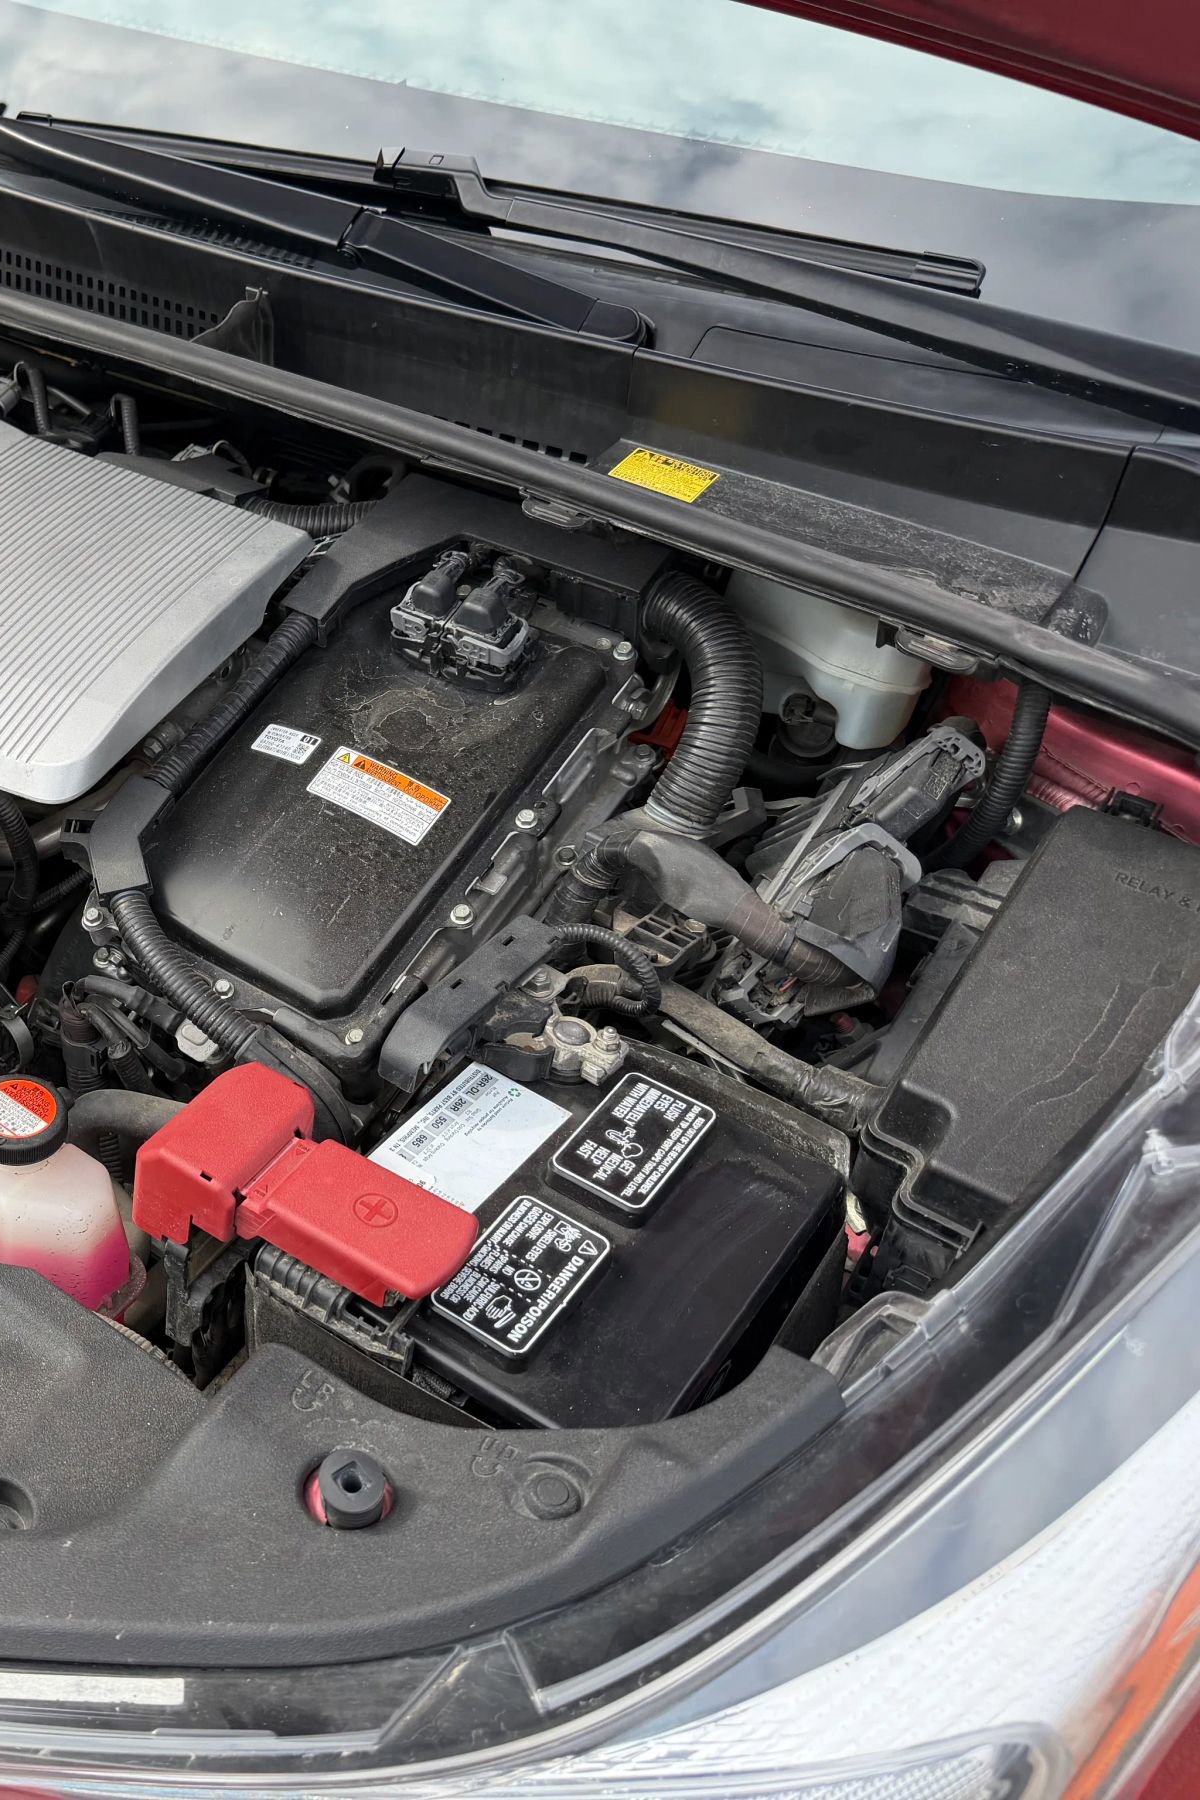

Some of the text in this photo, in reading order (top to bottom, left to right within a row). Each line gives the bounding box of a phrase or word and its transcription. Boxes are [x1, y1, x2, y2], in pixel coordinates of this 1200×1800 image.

[264, 734, 285, 744] TOYOTA
[369, 762, 398, 780] WARNING
[1114, 870, 1175, 900] RELAY
[455, 1069, 481, 1092] DISTRIBUTED
[465, 1074, 493, 1096] 26R-DL
[2, 1087, 48, 1119] AVERTISSEMENT
[20, 1086, 51, 1107] WARNING
[441, 1095, 453, 1106] BEST
[450, 1097, 467, 1112] 26R
[612, 1082, 649, 1118] WITH WATER
[624, 1088, 661, 1126] IMMEDIATELY
[654, 1094, 674, 1112] EYES
[427, 1103, 443, 1116] PARTS,
[664, 1100, 687, 1122] FLUSH
[431, 1116, 447, 1129] 550
[397, 1125, 420, 1143] MEMPHIS,
[411, 1134, 428, 1148] 685
[576, 1139, 598, 1159] FAST
[590, 1146, 610, 1165] HELP
[593, 1153, 623, 1180] MEDICAL
[618, 1159, 636, 1176] GET
[508, 1200, 532, 1224] BLINDNESS
[501, 1220, 513, 1230] OR
[502, 1206, 543, 1247] GASES CAN CAUSE
[526, 1212, 554, 1240] EXPLOSIVE
[469, 1244, 492, 1266] SMOKING
[525, 1229, 557, 1262] SHIELD EYES
[480, 1249, 500, 1270] FLAMES
[489, 1254, 509, 1274] SPARKS
[502, 1264, 515, 1276] NO
[440, 1266, 472, 1300] SEVERE BURNS
[449, 1271, 481, 1304] BLINDNESS OR
[463, 1276, 490, 1303] CAN CAUSE
[462, 1282, 500, 1321] SULFURIC ACID
[508, 1256, 583, 1341] DANGER/POISON
